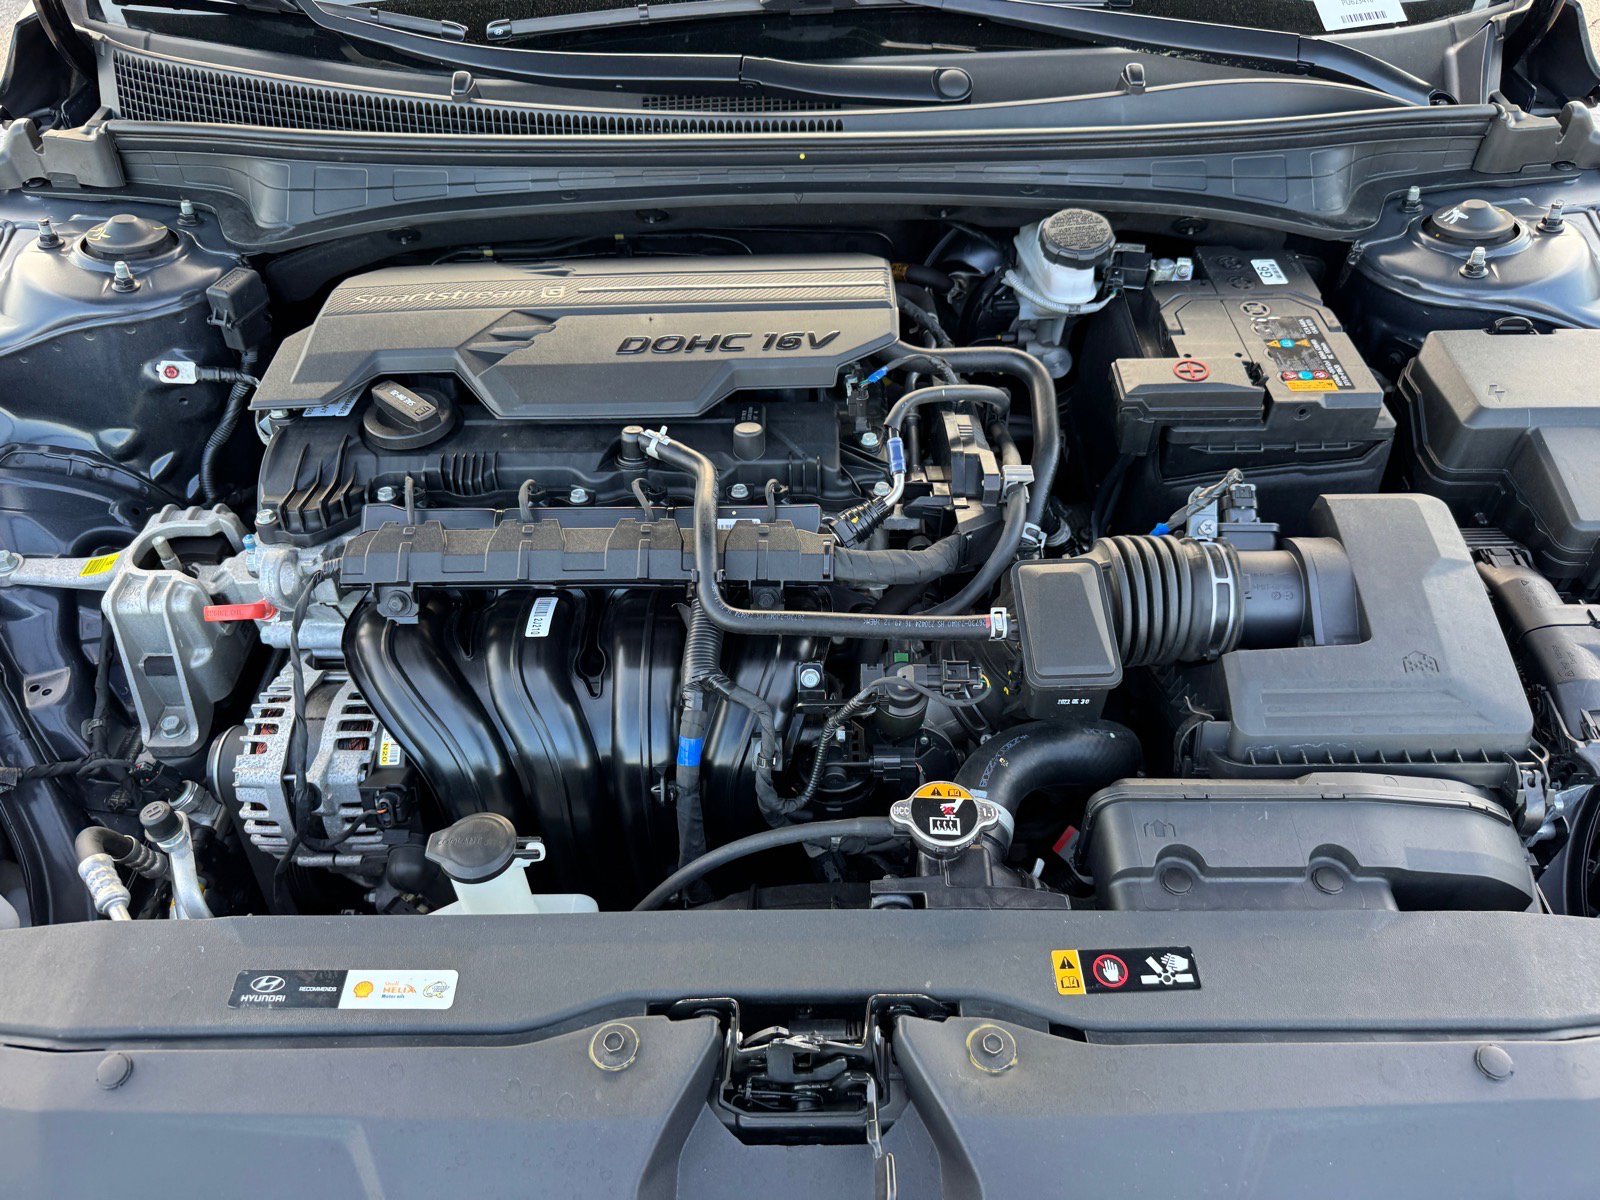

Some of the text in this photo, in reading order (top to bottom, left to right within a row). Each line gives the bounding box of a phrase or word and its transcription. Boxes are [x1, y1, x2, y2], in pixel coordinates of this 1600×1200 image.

[350, 289, 535, 305] Smartstream
[615, 330, 841, 355] DOHC 16V
[381, 743, 389, 762] N20
[383, 985, 416, 994] HELIX
[240, 994, 286, 1002] HYUNDAI
